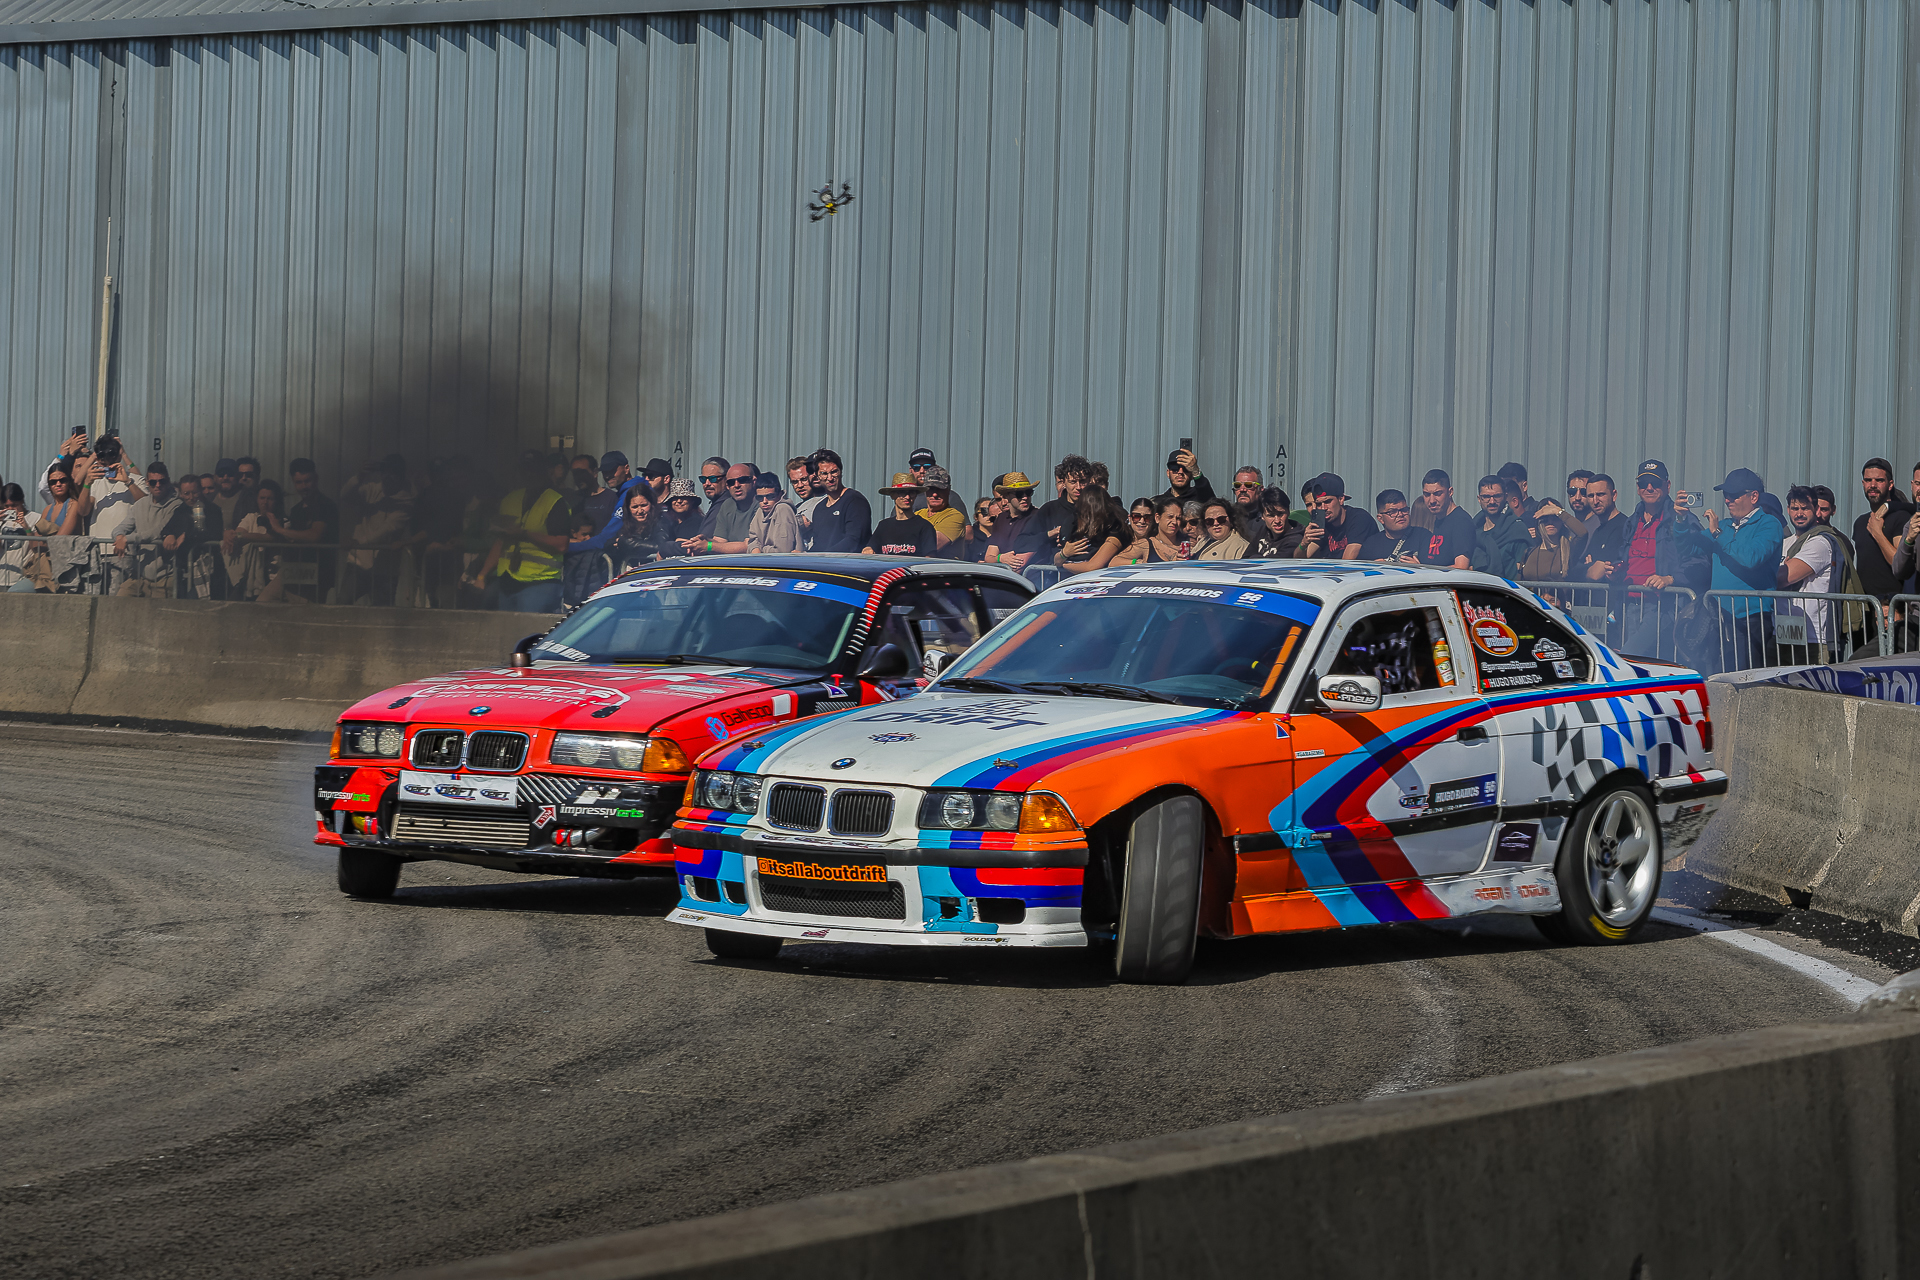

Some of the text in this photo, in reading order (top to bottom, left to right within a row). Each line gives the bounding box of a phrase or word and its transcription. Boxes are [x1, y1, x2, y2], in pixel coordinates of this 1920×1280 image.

[153, 437, 162, 451] B
[673, 440, 684, 454] A
[1275, 444, 1288, 459] A
[1267, 462, 1286, 478] 13
[687, 576, 723, 585] JOEL
[793, 580, 819, 592] 93
[1127, 585, 1224, 600] HUGO RAMOS
[1238, 592, 1265, 603] 56
[1321, 690, 1378, 704] KIT-PNEUS
[852, 711, 1050, 731] DRIFT
[768, 858, 887, 882] itsallaboutdrift
